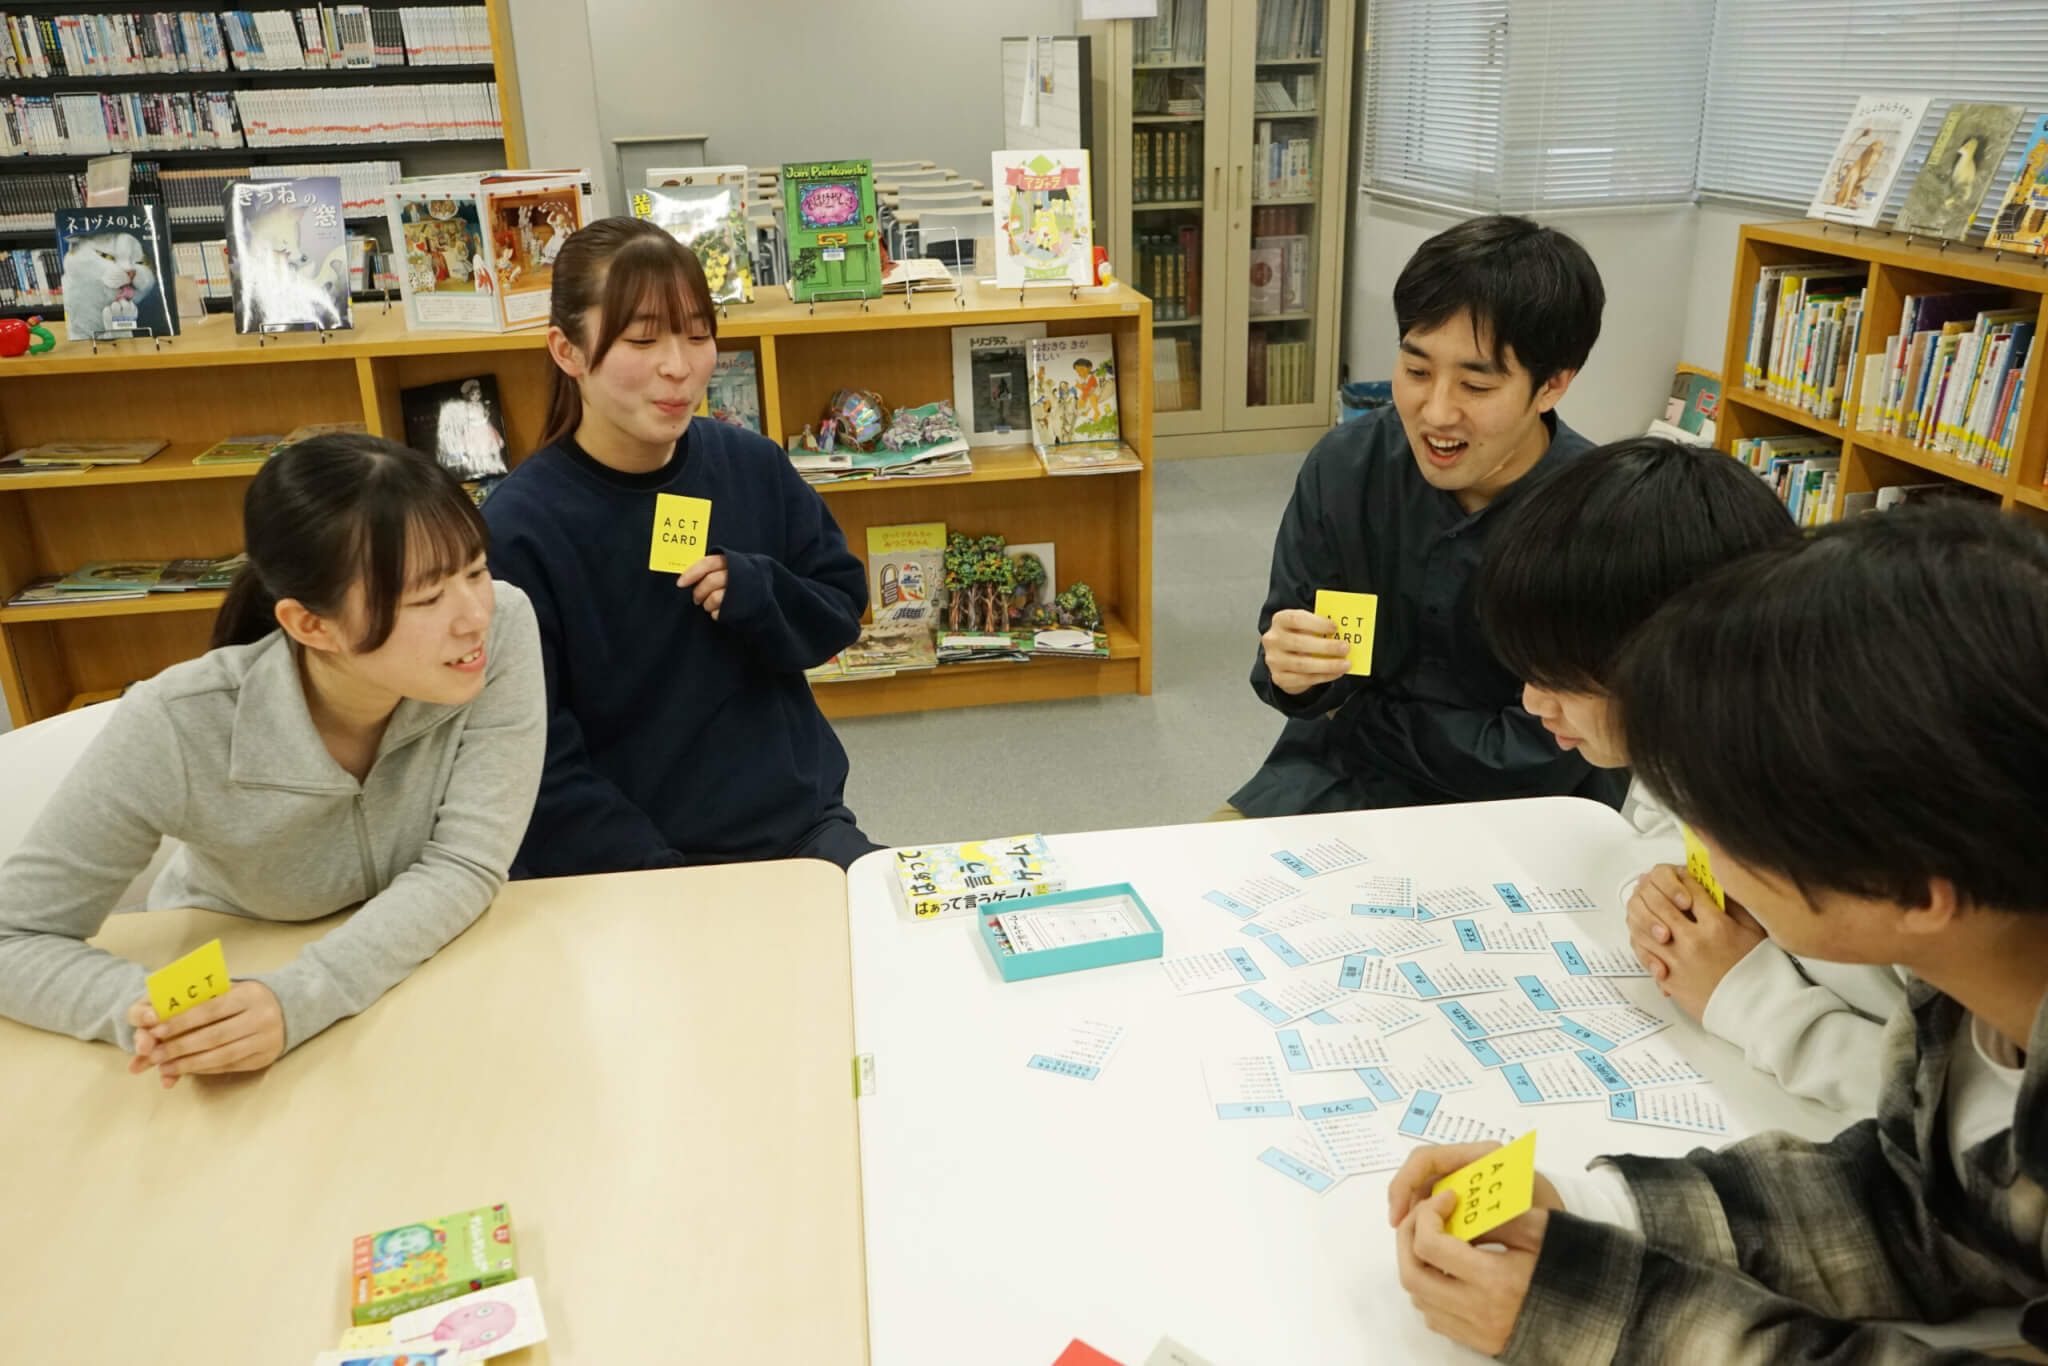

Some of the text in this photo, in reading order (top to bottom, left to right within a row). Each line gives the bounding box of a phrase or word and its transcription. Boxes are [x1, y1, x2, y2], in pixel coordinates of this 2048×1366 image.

[786, 167, 809, 178] Jan
[664, 517, 699, 530] ACT
[662, 532, 697, 546] CARD
[1327, 614, 1364, 628] CT
[1323, 632, 1362, 644] ARD
[168, 973, 213, 1012] ACT
[1486, 1162, 1504, 1212] ACT
[1463, 1172, 1483, 1225] CARD
